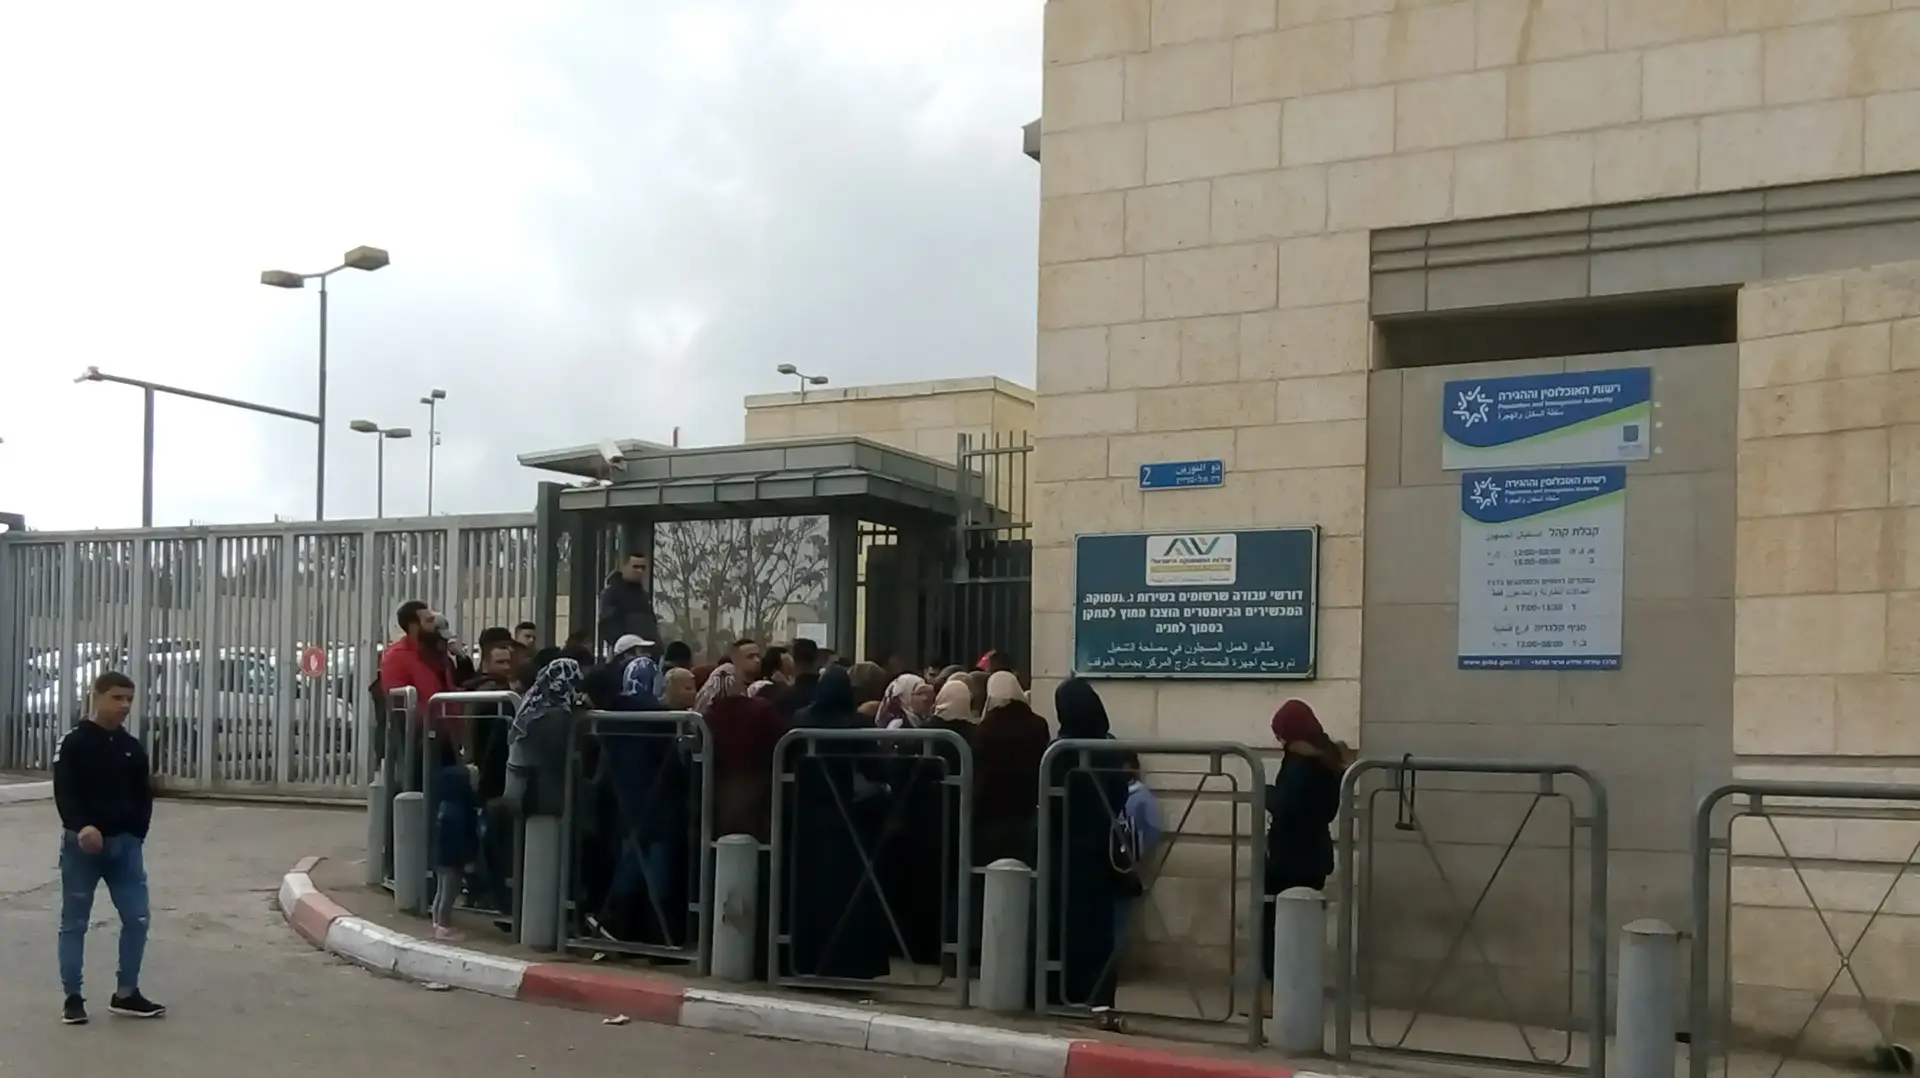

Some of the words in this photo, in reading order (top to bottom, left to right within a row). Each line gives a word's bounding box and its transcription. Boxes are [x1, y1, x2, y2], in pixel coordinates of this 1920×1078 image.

[1141, 466, 1152, 486] 2
[1549, 528, 1570, 538] קהל
[1572, 527, 1599, 538] קבלת
[1137, 592, 1176, 603] בשירות
[1178, 591, 1229, 602] שרשומים
[1232, 590, 1267, 601] עבודה
[1269, 589, 1303, 600] דורשי
[1082, 606, 1117, 621] למתקן
[1150, 607, 1180, 618] הוצבו
[1245, 606, 1303, 618] המכשירים
[1155, 621, 1187, 634] לחניה
[1188, 622, 1224, 636] בסמוך
[1169, 643, 1183, 656] في
